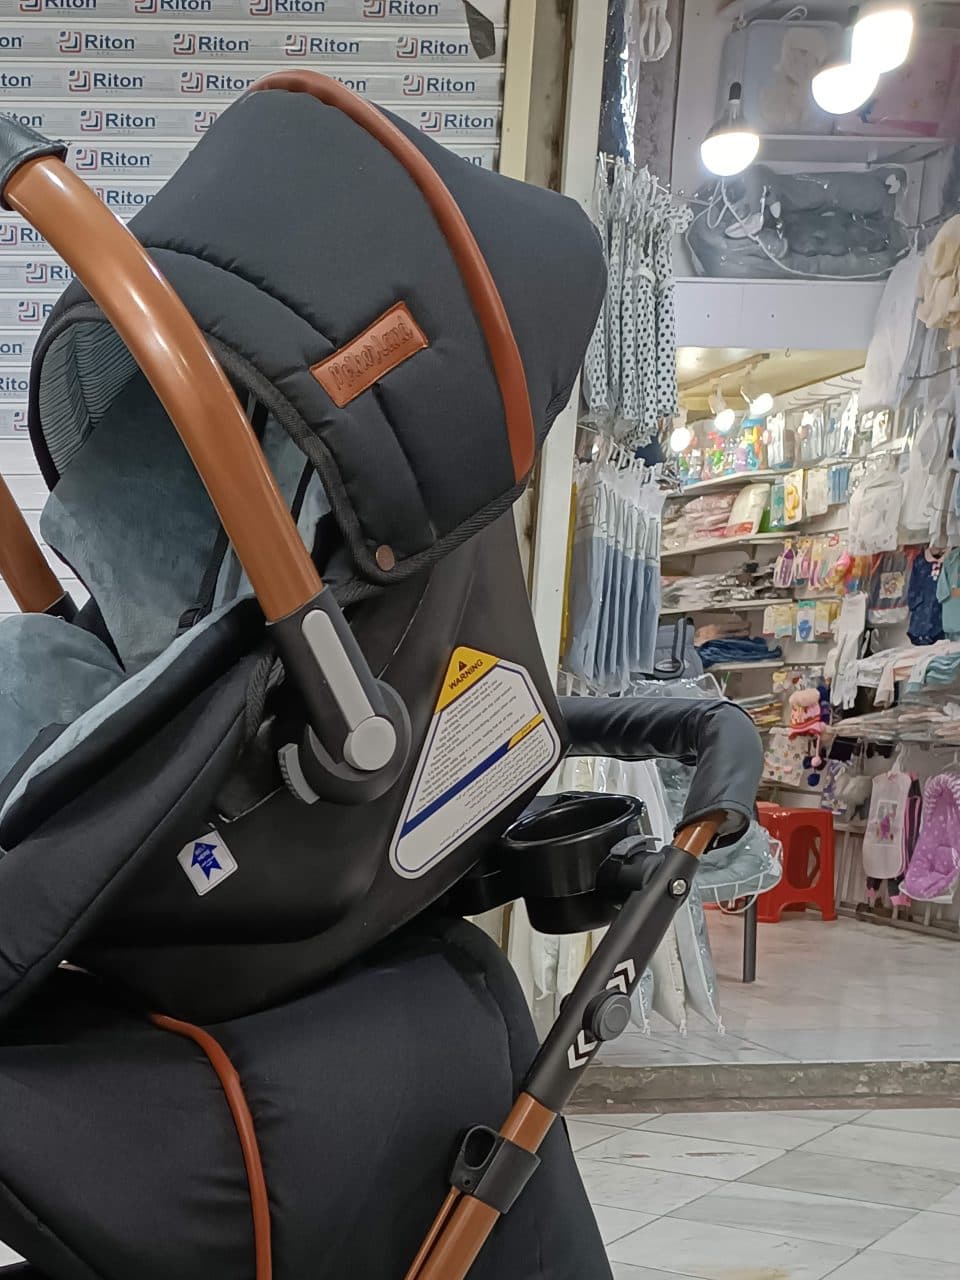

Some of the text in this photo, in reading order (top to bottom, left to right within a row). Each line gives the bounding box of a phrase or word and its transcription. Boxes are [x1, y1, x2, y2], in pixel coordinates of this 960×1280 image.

[159, 0, 211, 10] Riton
[275, 0, 325, 12] Riton
[390, 0, 438, 15] Riton
[85, 34, 135, 49] Riton
[198, 36, 249, 51] Riton
[310, 38, 360, 52] Riton
[420, 40, 469, 55] Riton
[93, 73, 143, 88] Riton
[427, 77, 475, 91] Riton
[106, 113, 155, 127] Riton
[444, 114, 494, 128] Riton
[101, 151, 150, 166] Riton
[448, 658, 484, 690] WARNING
